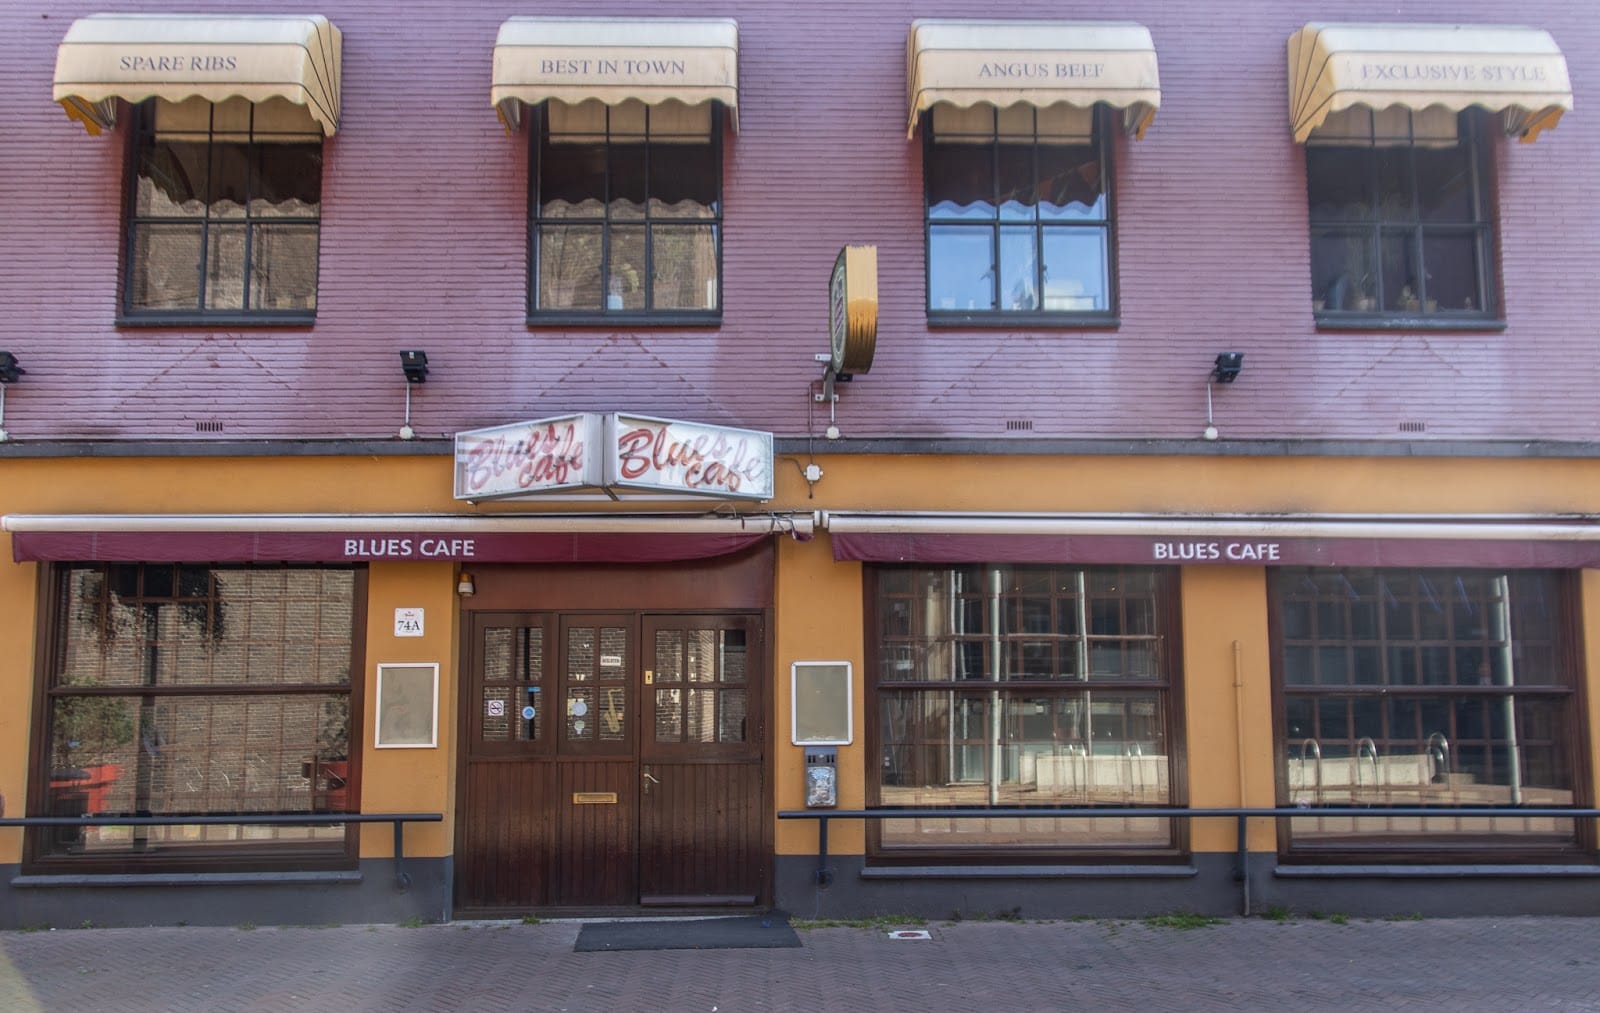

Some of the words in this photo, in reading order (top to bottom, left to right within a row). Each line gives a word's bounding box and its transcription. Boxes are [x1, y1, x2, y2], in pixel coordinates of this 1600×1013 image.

[120, 56, 185, 71] SPARE
[192, 56, 239, 71] RIBS
[541, 60, 593, 75] BEST
[597, 60, 618, 75] IN
[624, 60, 686, 76] TOWN
[979, 63, 1049, 78] ANGUS
[1055, 63, 1105, 78] BEEF
[1361, 64, 1477, 81] EXCLUSIVE
[1480, 65, 1547, 81] STYLE
[467, 423, 561, 490] Blues
[619, 425, 728, 479] Blues
[344, 539, 413, 556] BLUES
[419, 539, 475, 556] CAFE
[1154, 543, 1220, 560] BLUES
[1226, 543, 1280, 560] CAFE
[398, 620, 420, 631] 74A
